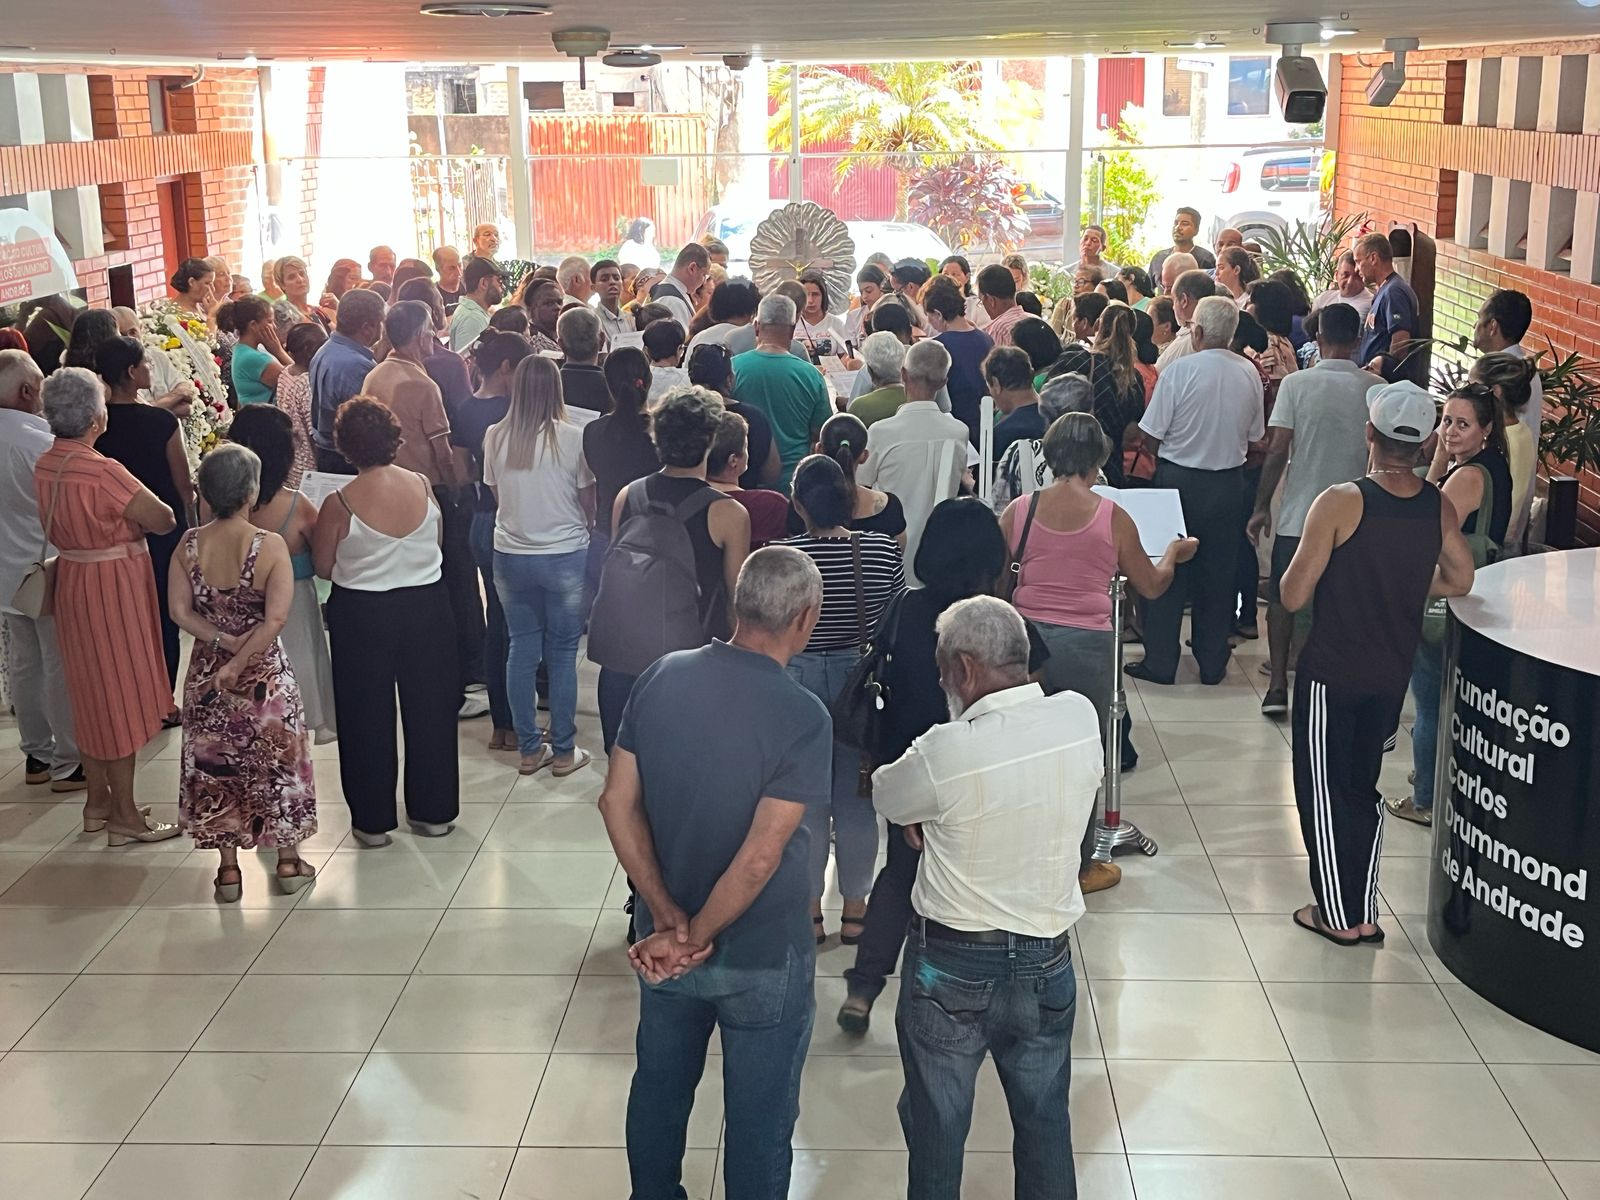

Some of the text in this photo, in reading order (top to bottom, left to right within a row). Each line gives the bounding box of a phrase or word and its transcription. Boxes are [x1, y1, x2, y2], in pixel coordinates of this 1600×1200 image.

[1451, 712, 1535, 784] Cultural
[1453, 666, 1570, 748] Fundação
[1448, 755, 1508, 819] Carlos
[1445, 797, 1588, 900] Drummond
[1442, 847, 1585, 949] de Andrade
